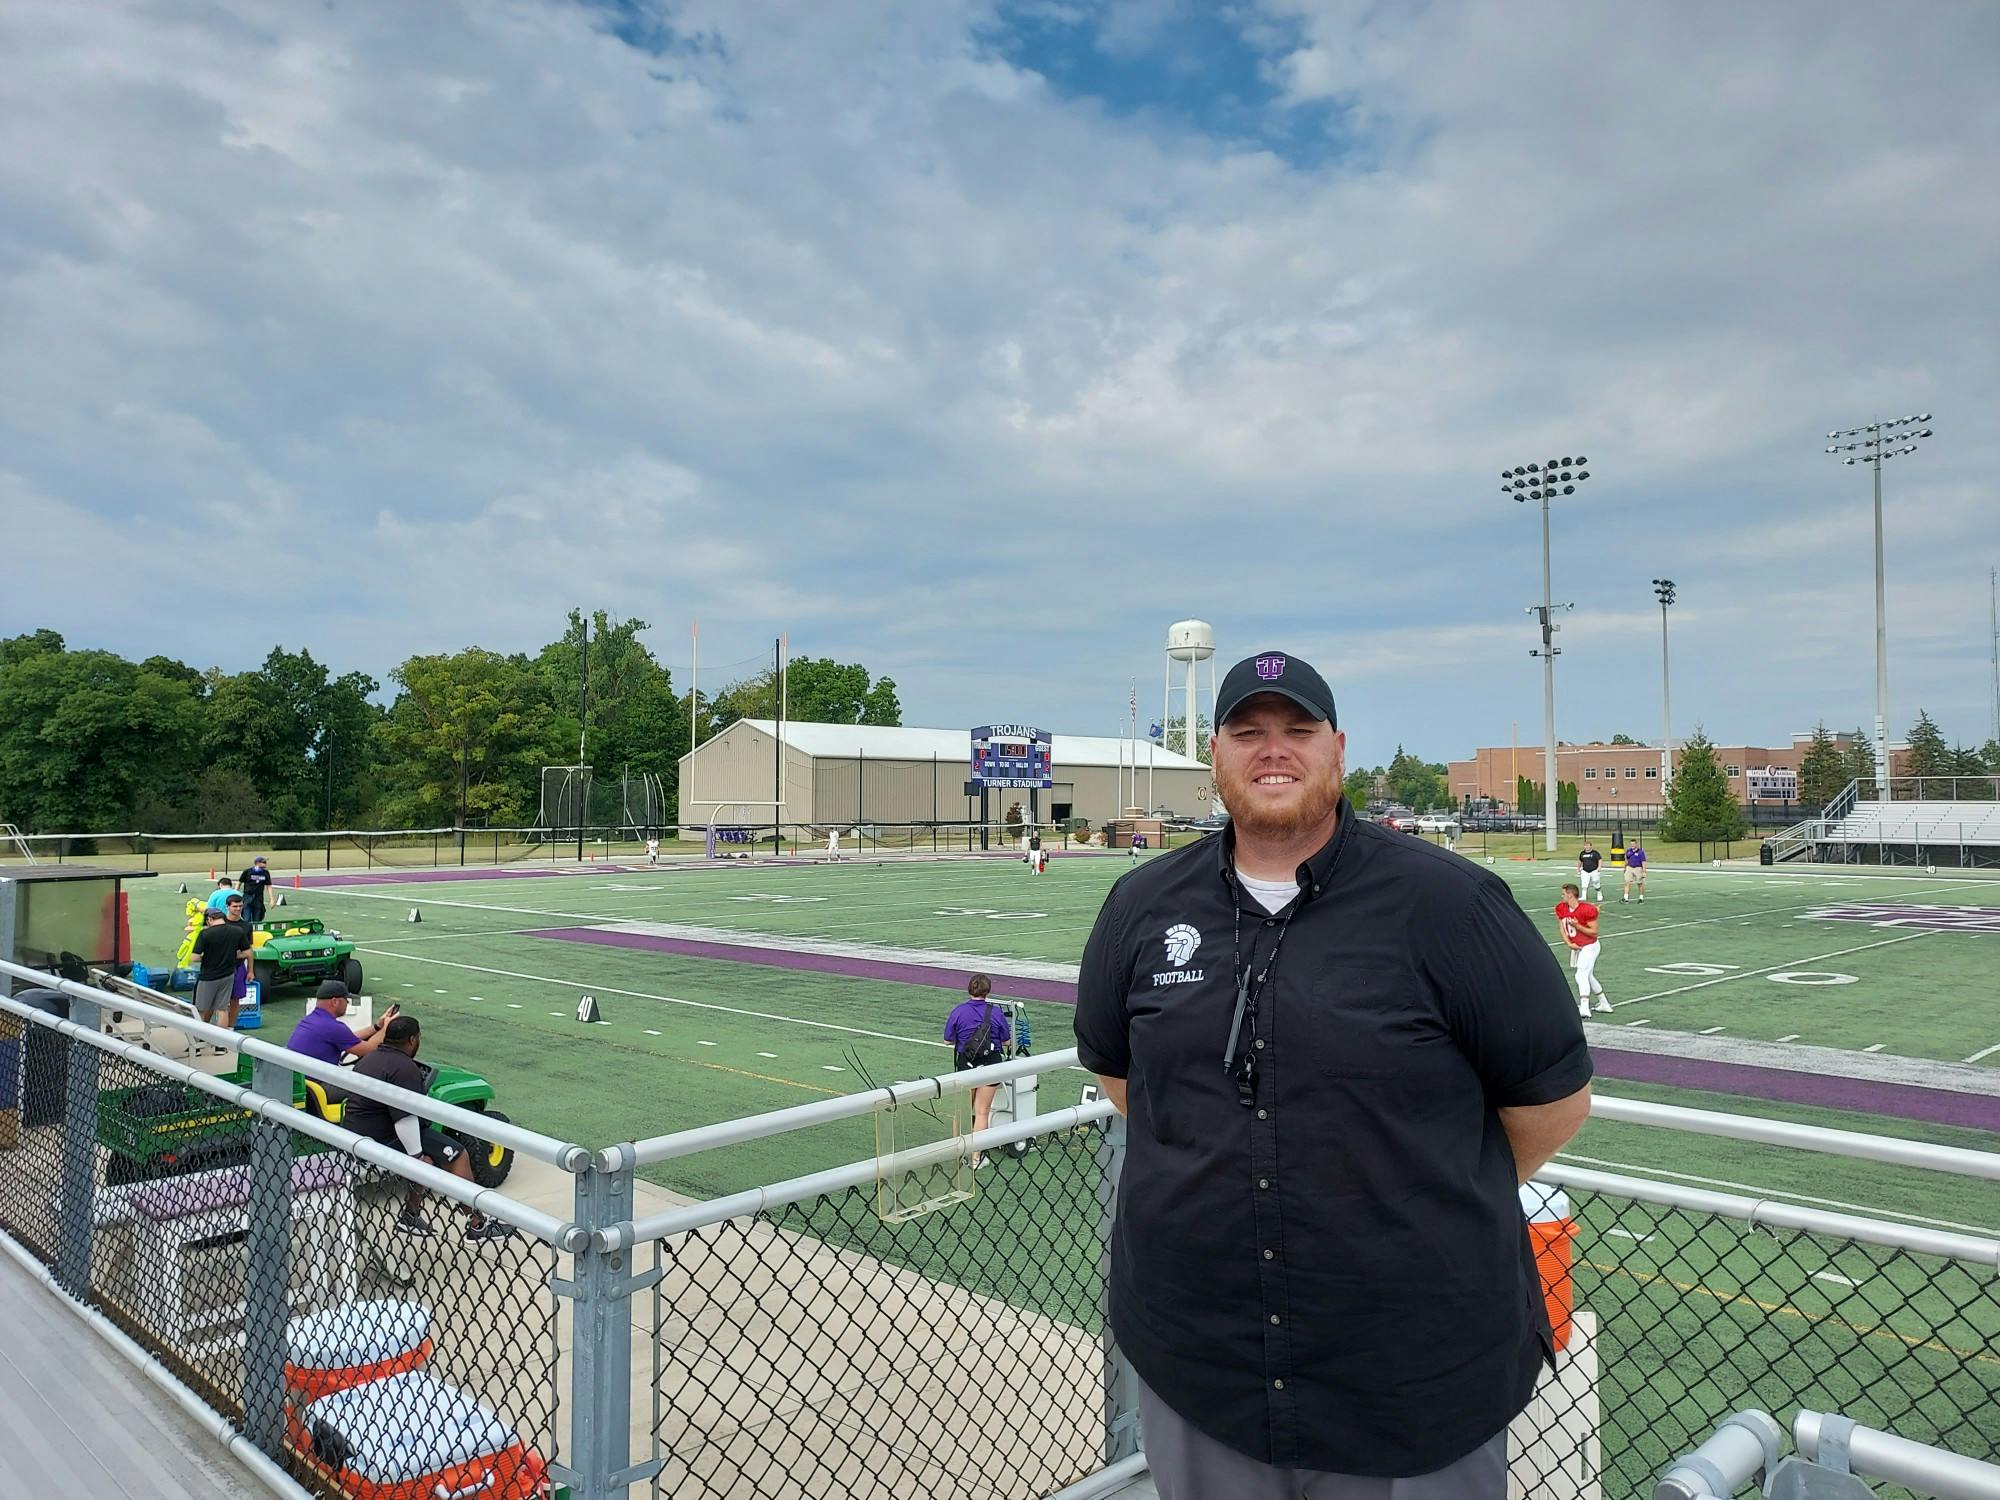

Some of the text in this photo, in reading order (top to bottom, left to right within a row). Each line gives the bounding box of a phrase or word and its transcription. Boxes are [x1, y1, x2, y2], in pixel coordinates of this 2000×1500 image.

[990, 725, 1037, 738] TROJANS
[983, 779, 1043, 788] TURNER STADIUM
[1152, 969, 1204, 986] FOOTBALL
[577, 995, 593, 1022] 40
